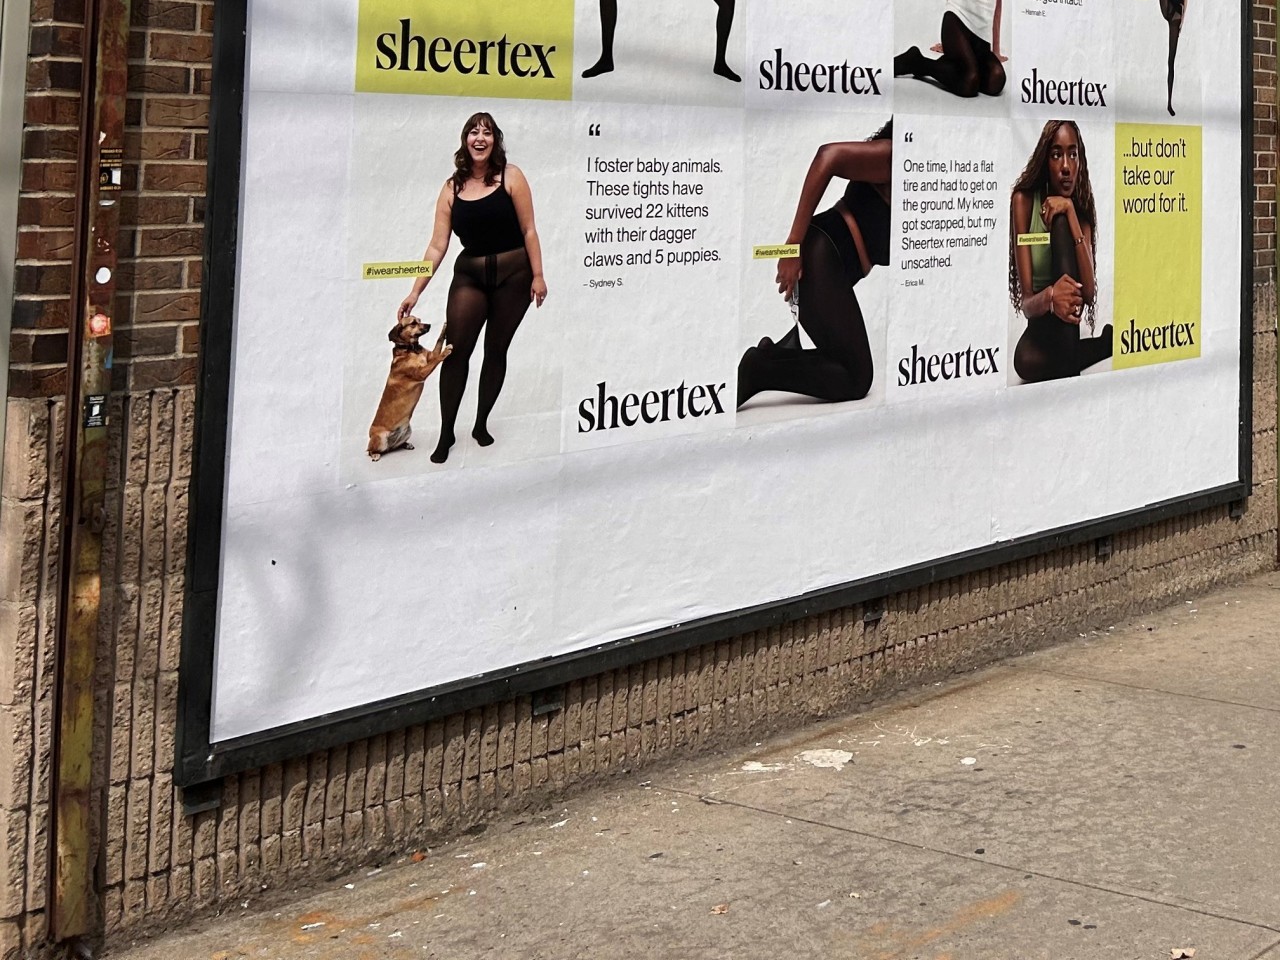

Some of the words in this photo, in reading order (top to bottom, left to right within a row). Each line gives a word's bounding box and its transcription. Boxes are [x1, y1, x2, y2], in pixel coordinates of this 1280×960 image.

[375, 18, 556, 79] sheertex
[759, 48, 882, 95] sheertex
[1020, 67, 1107, 107] sheertex
[1156, 138, 1186, 158] don't
[587, 157, 590, 172] I
[595, 157, 634, 172] foster
[637, 158, 669, 175] baby
[672, 159, 723, 173] animals.
[904, 159, 924, 172] One
[927, 160, 948, 173] time,
[955, 160, 971, 172] had
[973, 163, 978, 172] a
[980, 160, 994, 172] flat
[1123, 165, 1150, 185] take
[1154, 169, 1175, 185] our
[587, 181, 629, 196] These
[634, 181, 669, 198] tights
[673, 181, 703, 195] have
[903, 179, 918, 191] tire
[921, 180, 938, 191] and
[940, 179, 957, 191] had
[960, 181, 968, 191] to
[970, 180, 984, 193] get
[986, 181, 997, 190] on
[903, 199, 918, 211] the
[921, 198, 955, 213] ground.
[958, 198, 971, 211] My
[973, 197, 994, 209] knee
[1123, 193, 1155, 213] word
[1159, 192, 1176, 212] for
[1178, 193, 1188, 212] it.
[585, 204, 642, 220] survived
[646, 204, 662, 218] 22
[667, 203, 709, 217] kittens
[902, 219, 918, 233] got
[921, 216, 965, 232] scrapped,
[968, 216, 981, 228] but
[984, 217, 996, 229] my
[585, 228, 613, 243] with
[617, 227, 647, 242] their
[650, 227, 696, 243] dagger
[902, 237, 944, 250] Sheertex
[946, 234, 987, 248] remained
[584, 251, 623, 267] claws
[627, 249, 651, 265] and
[655, 249, 663, 264] 5
[667, 247, 721, 266] puppies.
[901, 254, 952, 269] unscathed.
[366, 265, 430, 276] #iwearsheertex
[589, 280, 615, 289] Sydney
[617, 278, 623, 286] S.
[1120, 319, 1195, 355] sheertex
[898, 343, 999, 387] sheertex
[578, 379, 726, 434] sheertex
